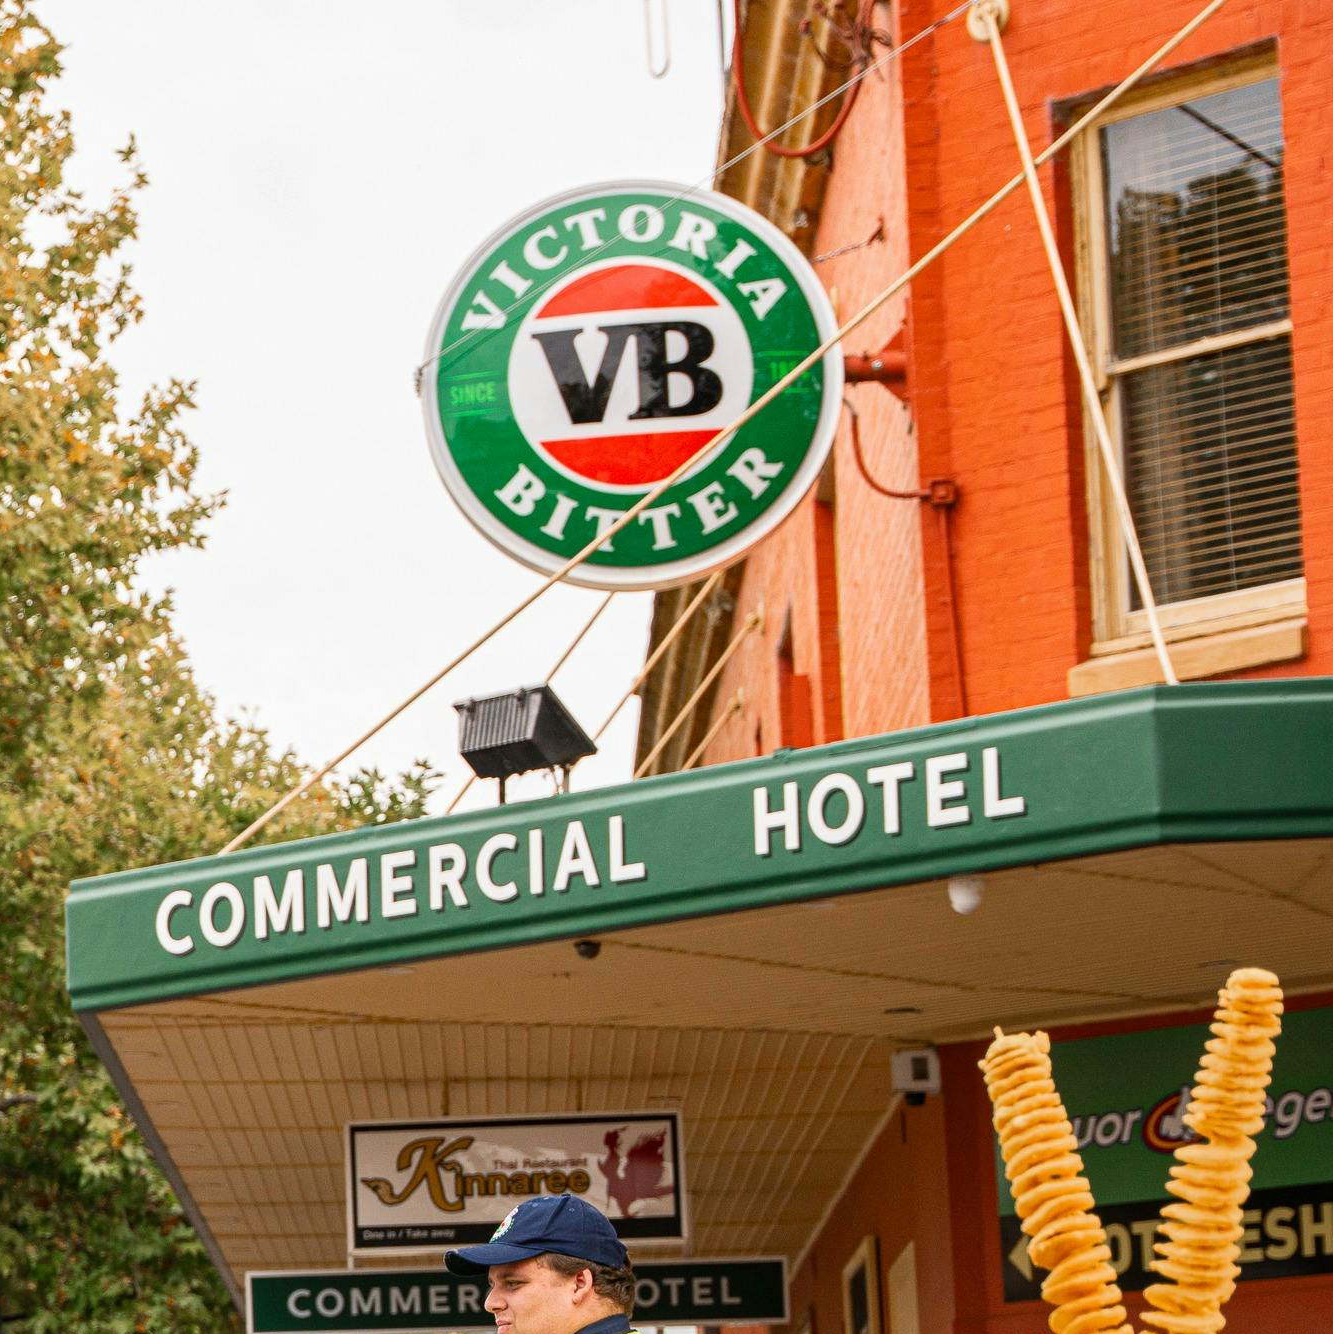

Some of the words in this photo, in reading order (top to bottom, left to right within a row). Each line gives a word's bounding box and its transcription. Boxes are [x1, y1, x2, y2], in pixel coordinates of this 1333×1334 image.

[461, 203, 789, 333] VICTORIA
[450, 380, 496, 406] SINCE
[531, 321, 723, 425] VB
[494, 447, 784, 552] BITTER
[155, 814, 645, 956] COMMERCIAL
[753, 747, 1026, 857] HOTEL
[361, 1136, 591, 1212] Kinnaree
[492, 1158, 517, 1171] Thai
[523, 1156, 588, 1170] Restaurant
[287, 1283, 482, 1319] COMMER
[634, 1275, 742, 1309] OTEL
